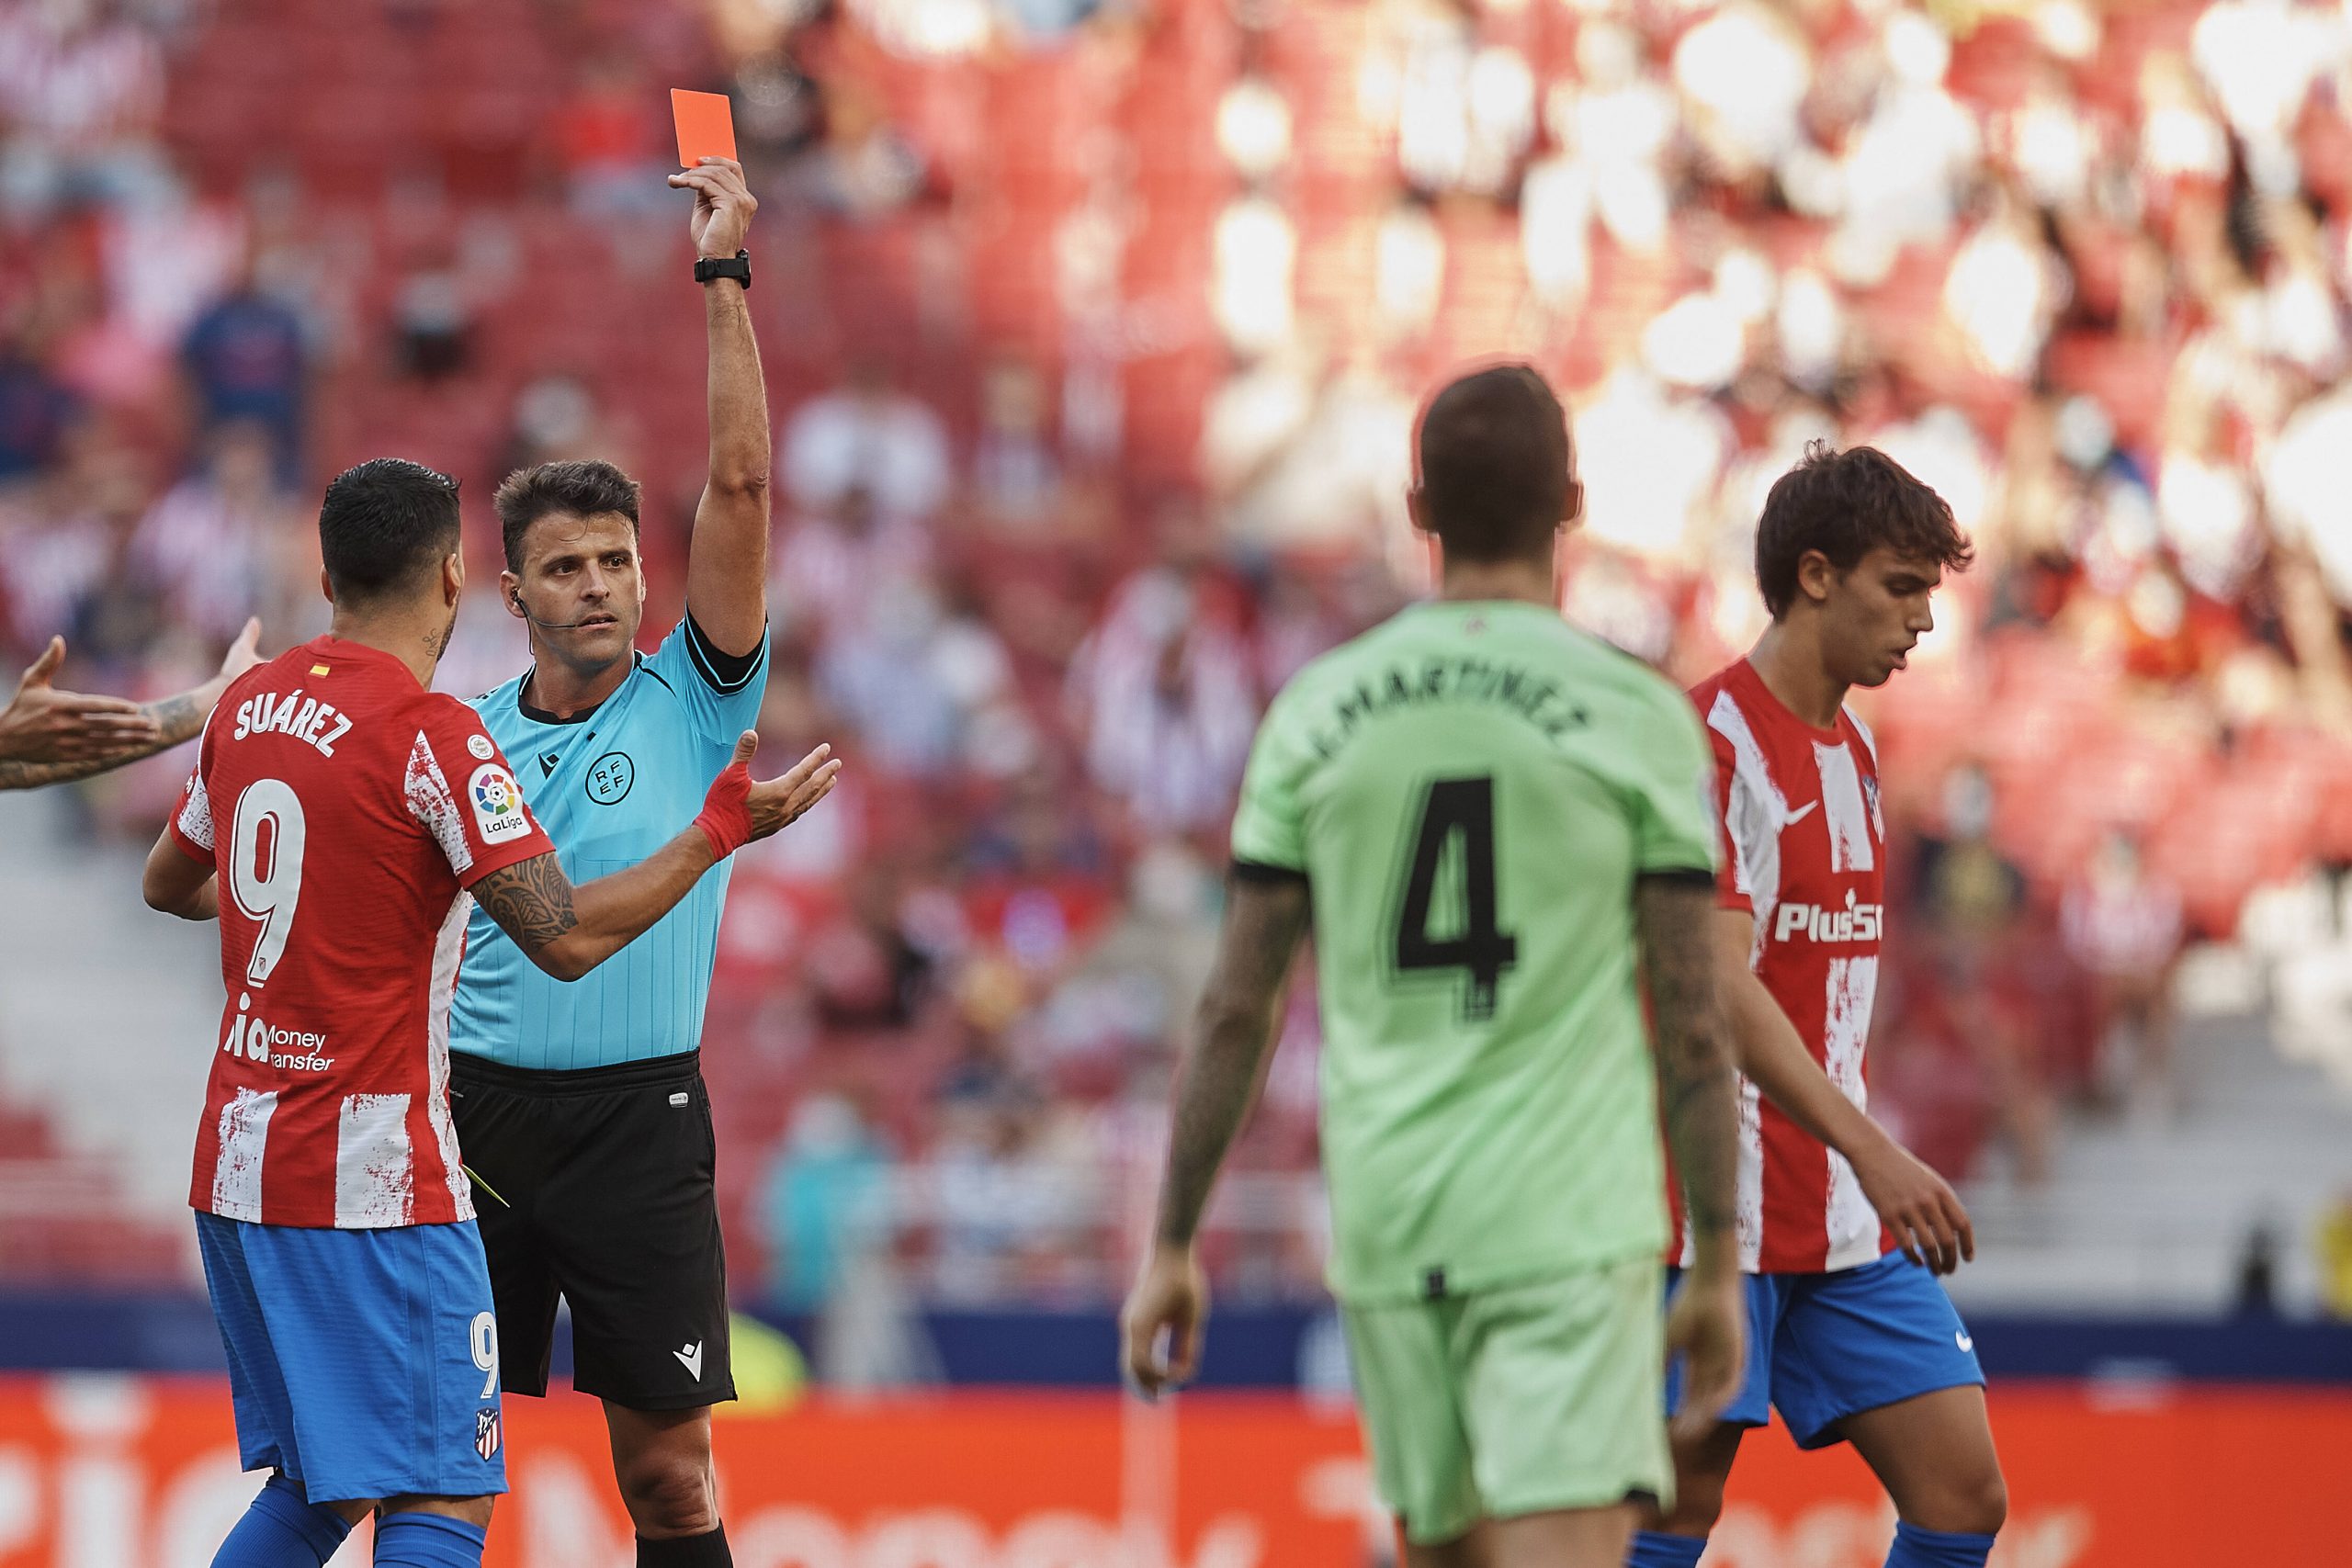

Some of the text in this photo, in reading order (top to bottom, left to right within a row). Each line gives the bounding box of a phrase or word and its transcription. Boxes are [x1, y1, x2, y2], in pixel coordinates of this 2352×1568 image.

[234, 689, 353, 758] SUÁREZ
[485, 817, 523, 833] LaLiga
[230, 779, 305, 988] 9
[1381, 776, 1518, 1021] 4
[469, 1311, 499, 1399] 9
